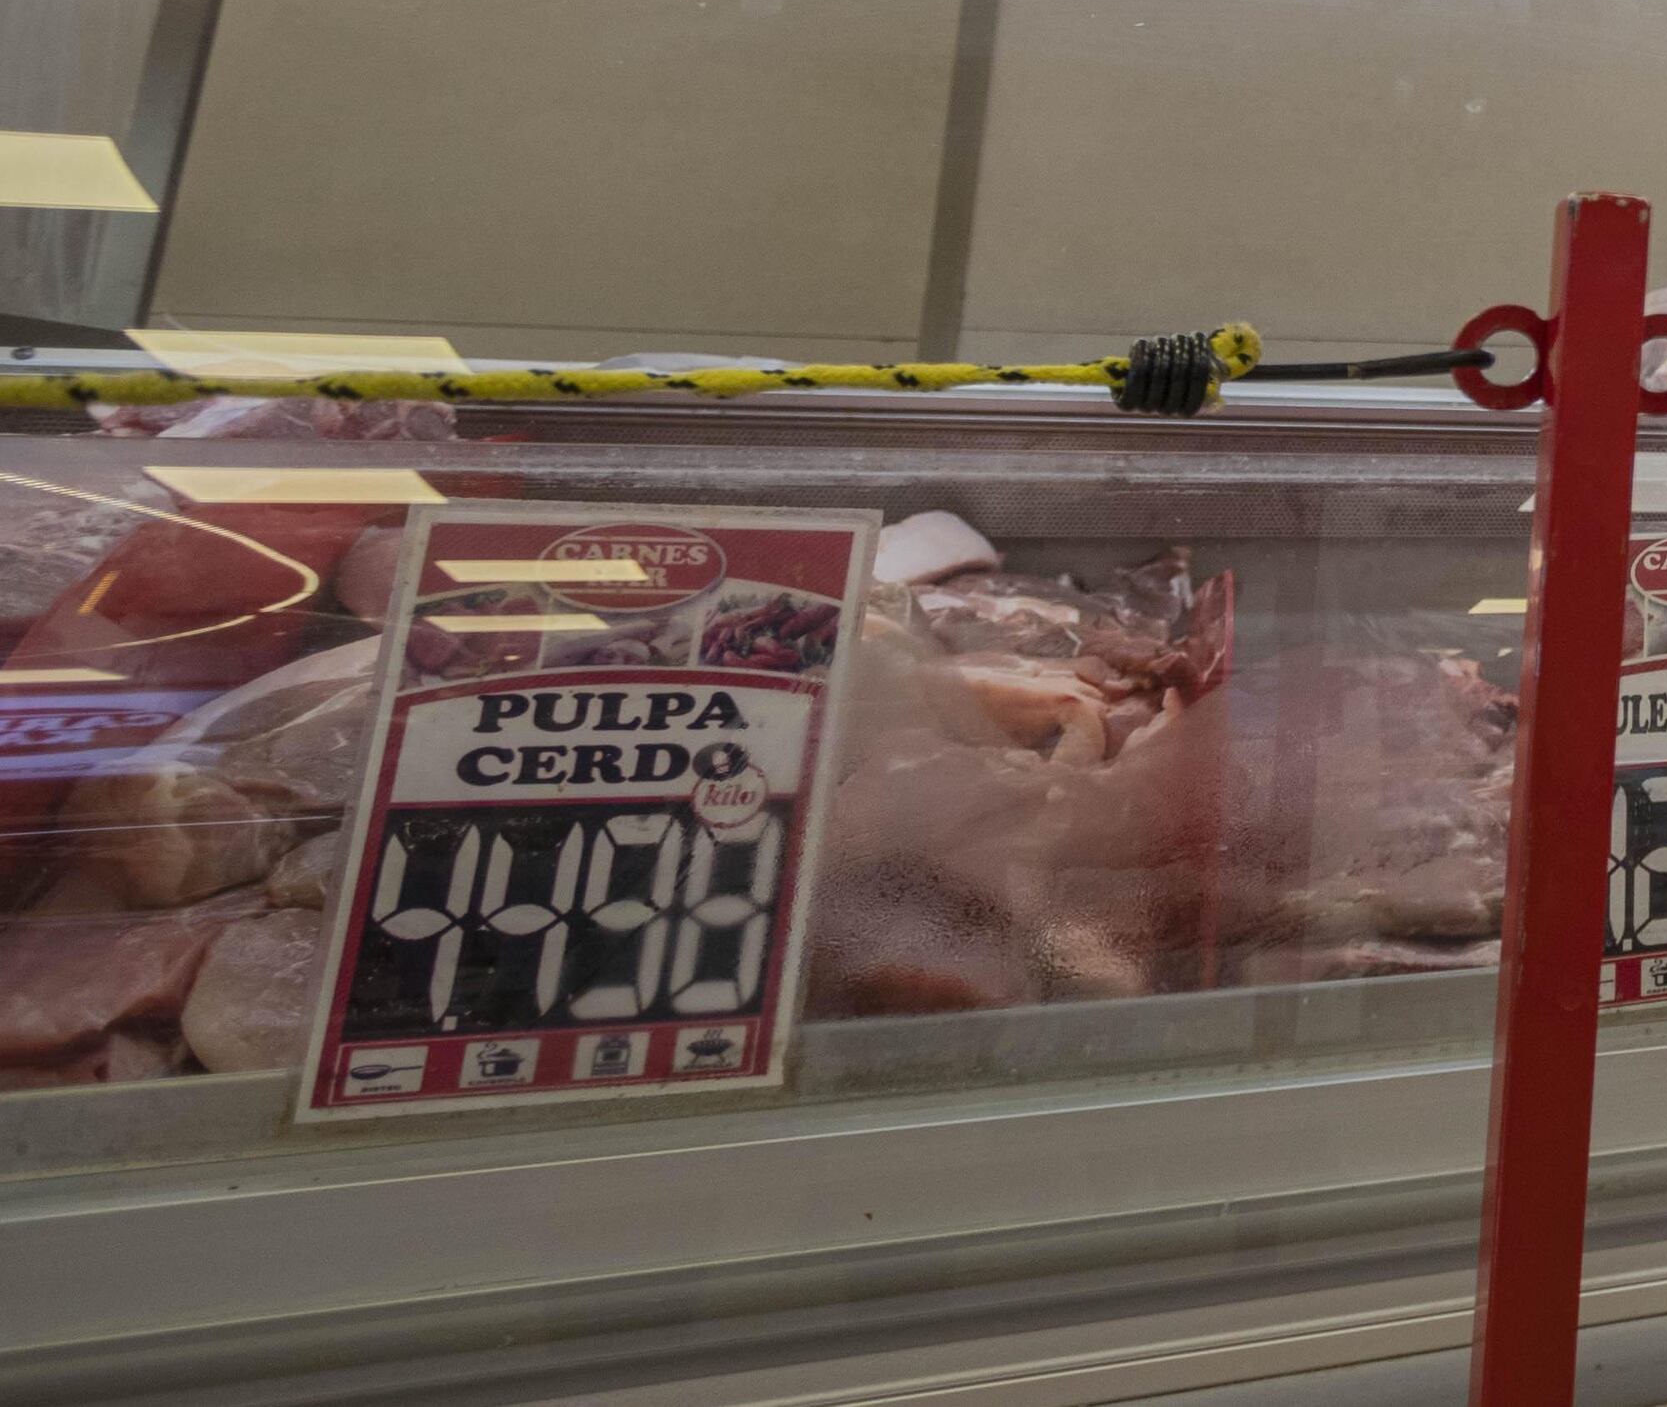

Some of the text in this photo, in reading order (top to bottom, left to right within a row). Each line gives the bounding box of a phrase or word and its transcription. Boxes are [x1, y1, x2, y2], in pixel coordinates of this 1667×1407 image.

[556, 542, 708, 566] CARNES
[472, 691, 748, 733] PULPA
[456, 741, 750, 786] CERDO
[700, 780, 756, 809] kilo
